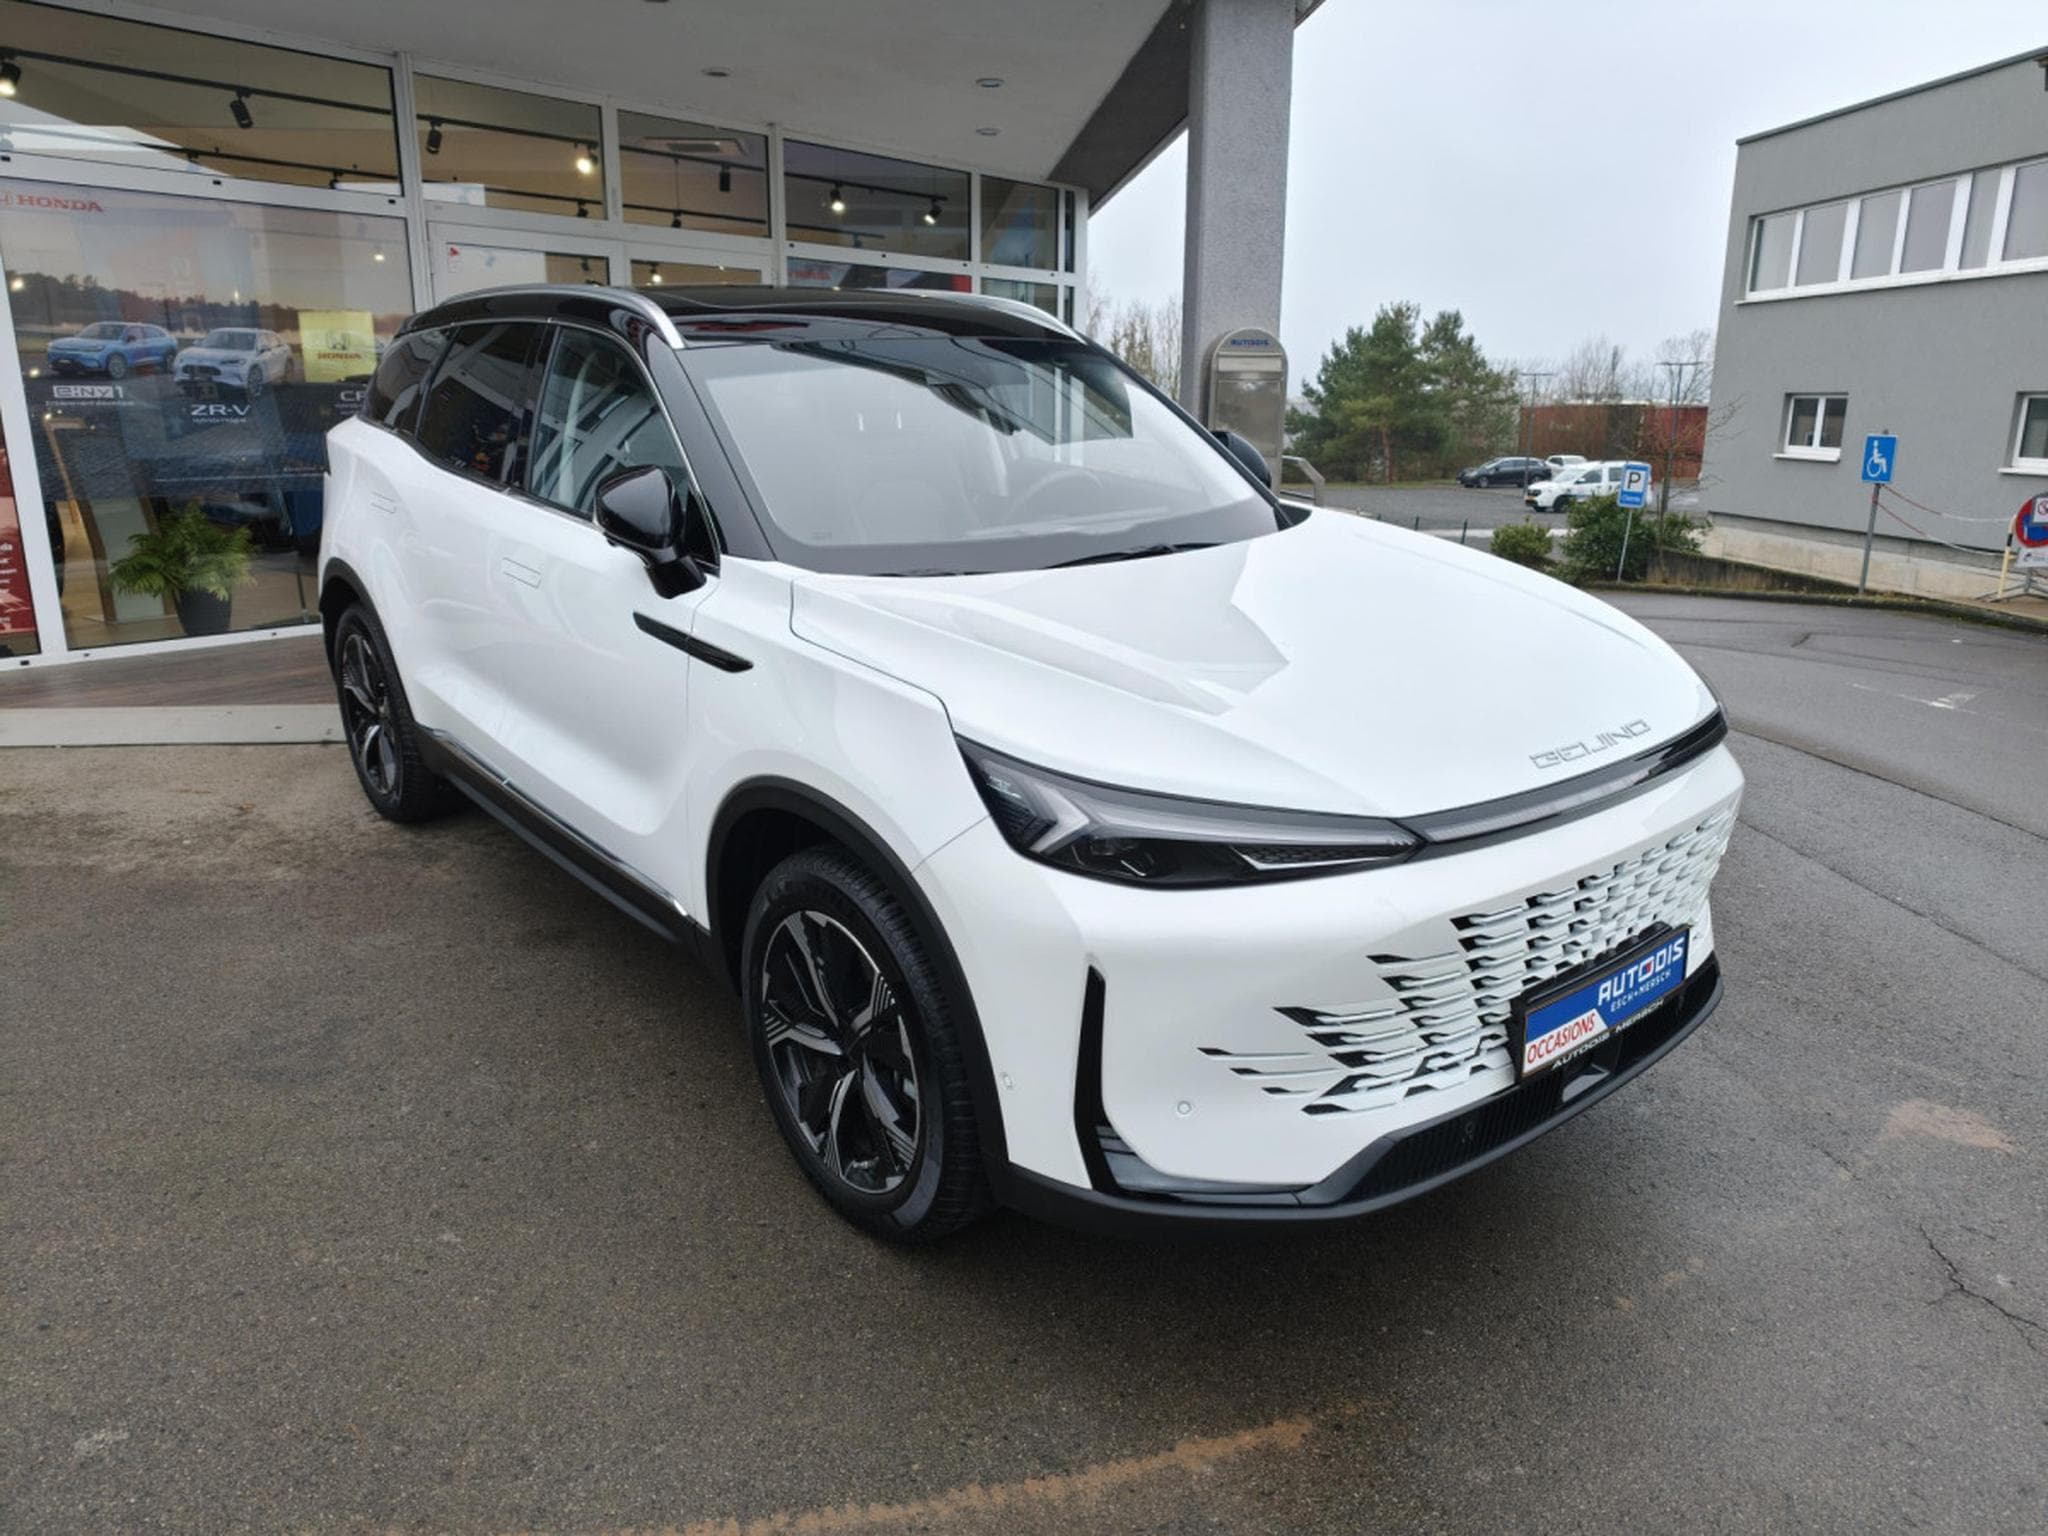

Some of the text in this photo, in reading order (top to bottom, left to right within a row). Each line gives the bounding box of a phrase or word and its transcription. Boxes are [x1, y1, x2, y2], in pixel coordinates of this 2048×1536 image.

[16, 194, 104, 213] HONDA
[191, 404, 251, 416] ZR-V
[1627, 471, 1642, 489] P
[1598, 936, 1685, 1007] AUTODIS
[1527, 1012, 1596, 1064] OCCASIONS
[1552, 1031, 1611, 1071] AUTODIS
